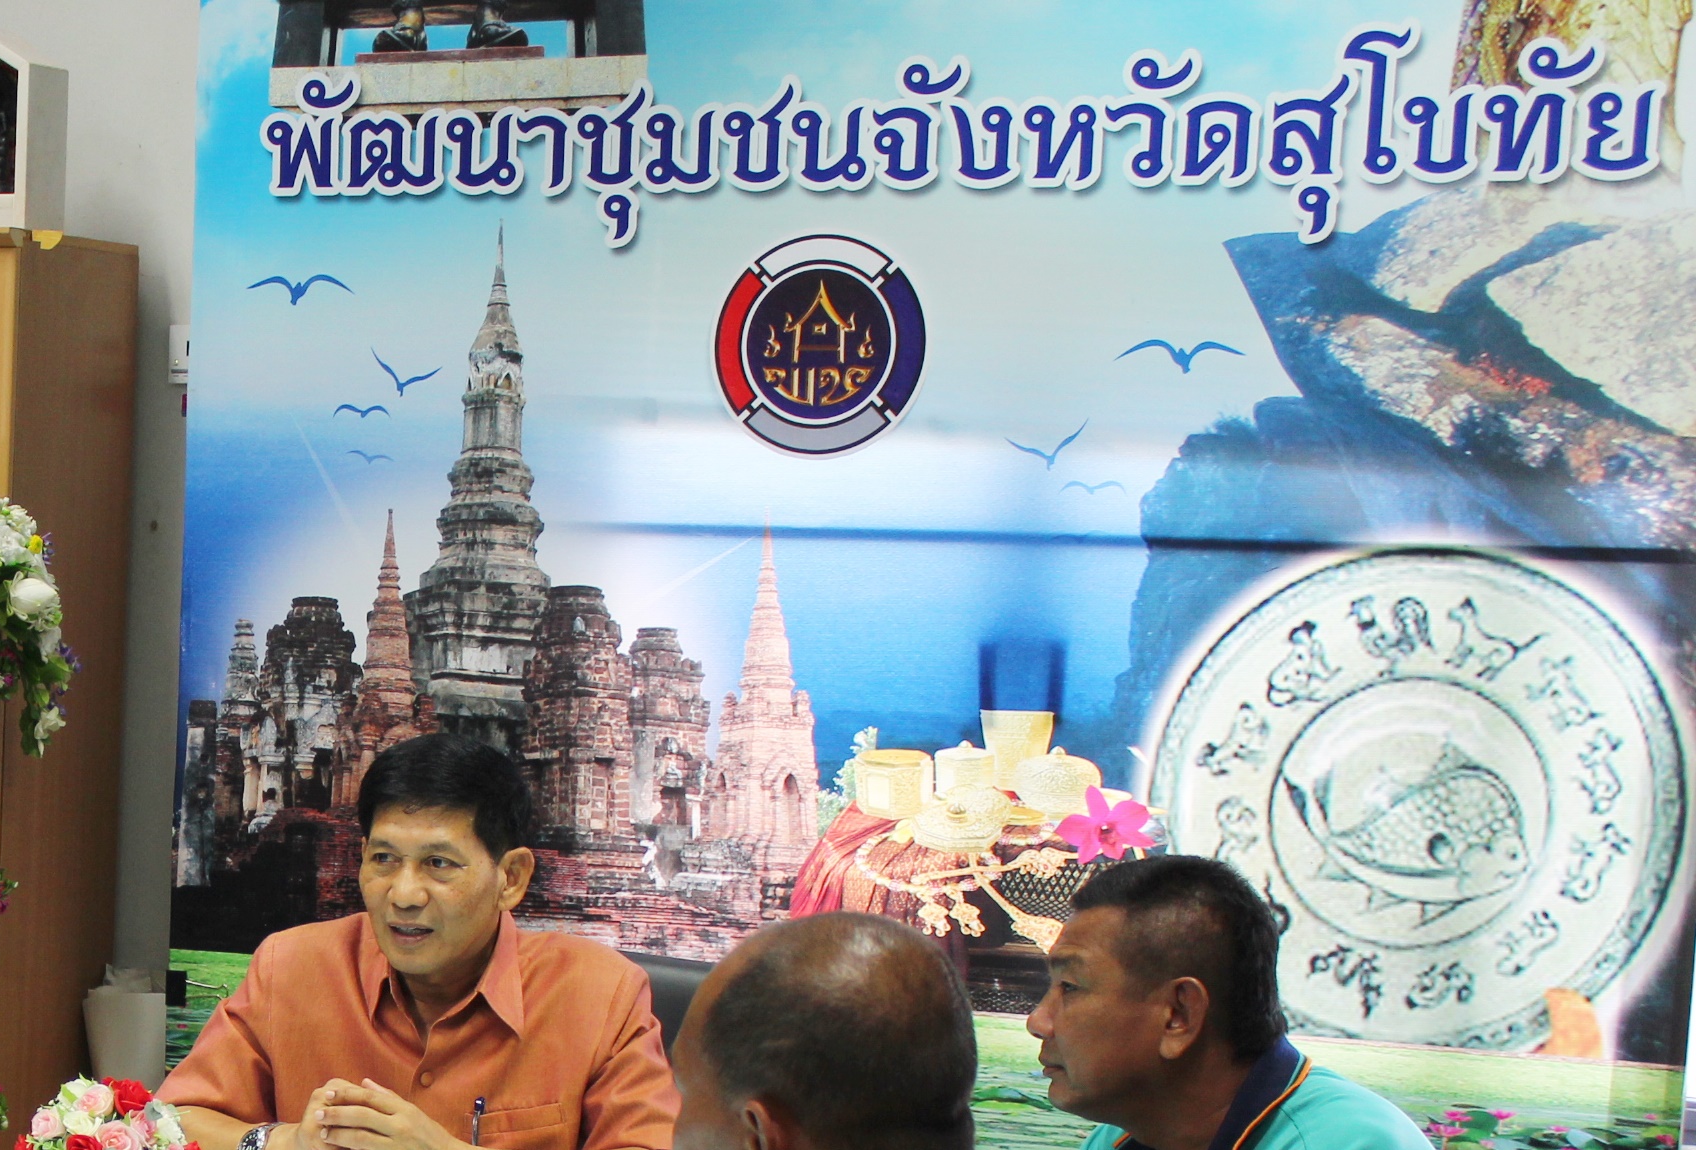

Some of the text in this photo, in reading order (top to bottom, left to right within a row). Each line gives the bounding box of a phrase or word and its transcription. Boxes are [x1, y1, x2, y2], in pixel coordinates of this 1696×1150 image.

[266, 27, 1662, 242] พัฒนาชุมชนจังหวัดสุโขทัย
